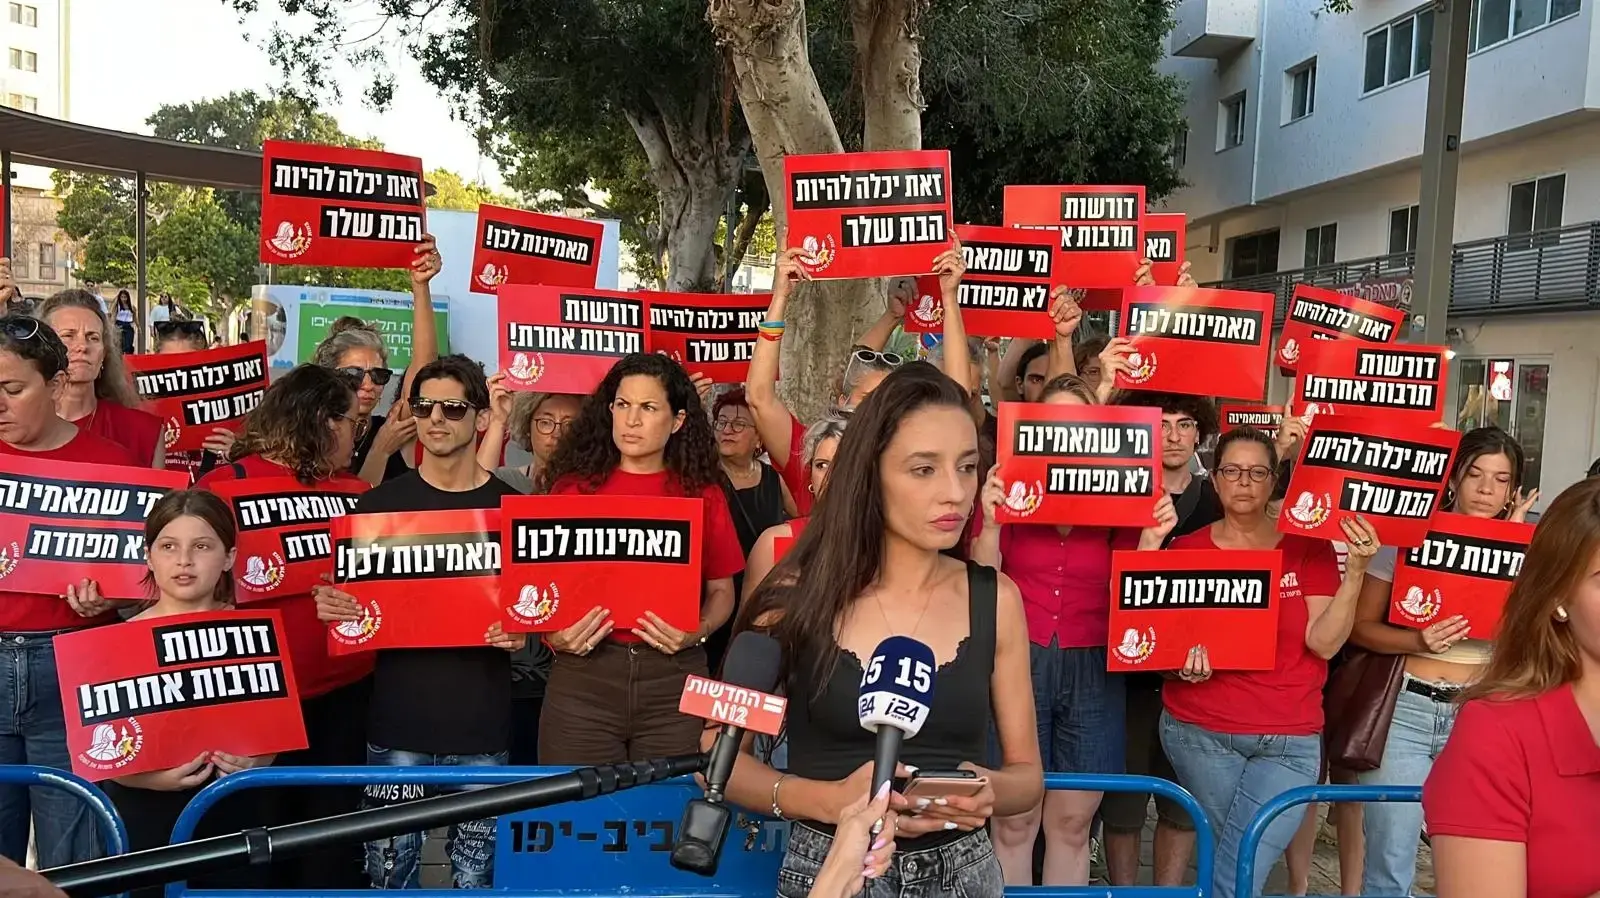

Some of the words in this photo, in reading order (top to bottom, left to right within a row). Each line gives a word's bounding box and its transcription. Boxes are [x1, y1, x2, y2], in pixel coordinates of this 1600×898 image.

[275, 165, 335, 191] להיות
[339, 169, 381, 194] יכלה
[387, 175, 418, 198] זאת
[796, 175, 851, 201] להיות
[856, 174, 899, 199] יכלה
[905, 174, 941, 197] זאת
[1065, 197, 1134, 219] דורשות
[327, 208, 373, 237] שלך
[379, 215, 421, 240] הבת
[847, 216, 893, 246] שלך
[900, 215, 943, 241] הבת
[487, 225, 520, 249] לכן!
[521, 234, 588, 260] מאמינות
[1077, 226, 1133, 246] תרבות
[962, 247, 1023, 271] שמאמ
[1029, 250, 1048, 272] מי
[1023, 286, 1046, 307] לא
[566, 300, 639, 325] דורשות
[650, 309, 694, 327] להיות
[698, 310, 733, 328] יכלה
[738, 311, 767, 328] את
[1130, 307, 1170, 334] לכן!
[1294, 301, 1328, 321] להיות
[1326, 308, 1360, 328] יכלה
[511, 322, 574, 349] אחרת!
[1172, 312, 1256, 341] מאמינות
[1359, 318, 1391, 340] זאת
[580, 329, 639, 353] תרבות
[690, 341, 728, 361] שלך
[191, 366, 229, 388] יכלה
[233, 359, 261, 381] זאת
[1360, 354, 1436, 378] דורשות
[137, 370, 187, 393] להיות
[1306, 375, 1367, 401] אחרת!
[1371, 382, 1432, 406] תרבות
[187, 399, 229, 424] שלך
[1229, 413, 1270, 423] שמאמינה
[1019, 426, 1120, 453] שמאמינה
[1127, 429, 1148, 454] מי
[1308, 437, 1364, 463] להיות
[1365, 442, 1411, 469] יכלה
[1412, 451, 1447, 475] זאת
[1050, 469, 1119, 492] מפחדת
[1125, 468, 1149, 492] לא
[1349, 482, 1395, 513] שלך
[1394, 491, 1434, 516] הבת
[240, 497, 345, 525] שמאמינה
[29, 530, 118, 558] מפחדת
[123, 535, 148, 559] א
[286, 534, 331, 558] חדת
[519, 525, 569, 559] לכן!
[574, 529, 681, 557] מאמינות
[338, 539, 386, 578] לכן!
[392, 538, 501, 573] מאמינות
[1460, 545, 1525, 577] מינות
[1125, 577, 1167, 606] לכן!
[1170, 579, 1262, 603] מאמינות
[162, 626, 270, 662] דורשות
[191, 663, 279, 699] תרבות
[894, 656, 932, 693] 15
[80, 672, 185, 719] אחרת!
[686, 679, 761, 708] החדשות
[711, 700, 748, 728] N12
[884, 697, 920, 722] i24
[402, 783, 424, 800] RUN
[510, 820, 677, 853] ביב-יפו
